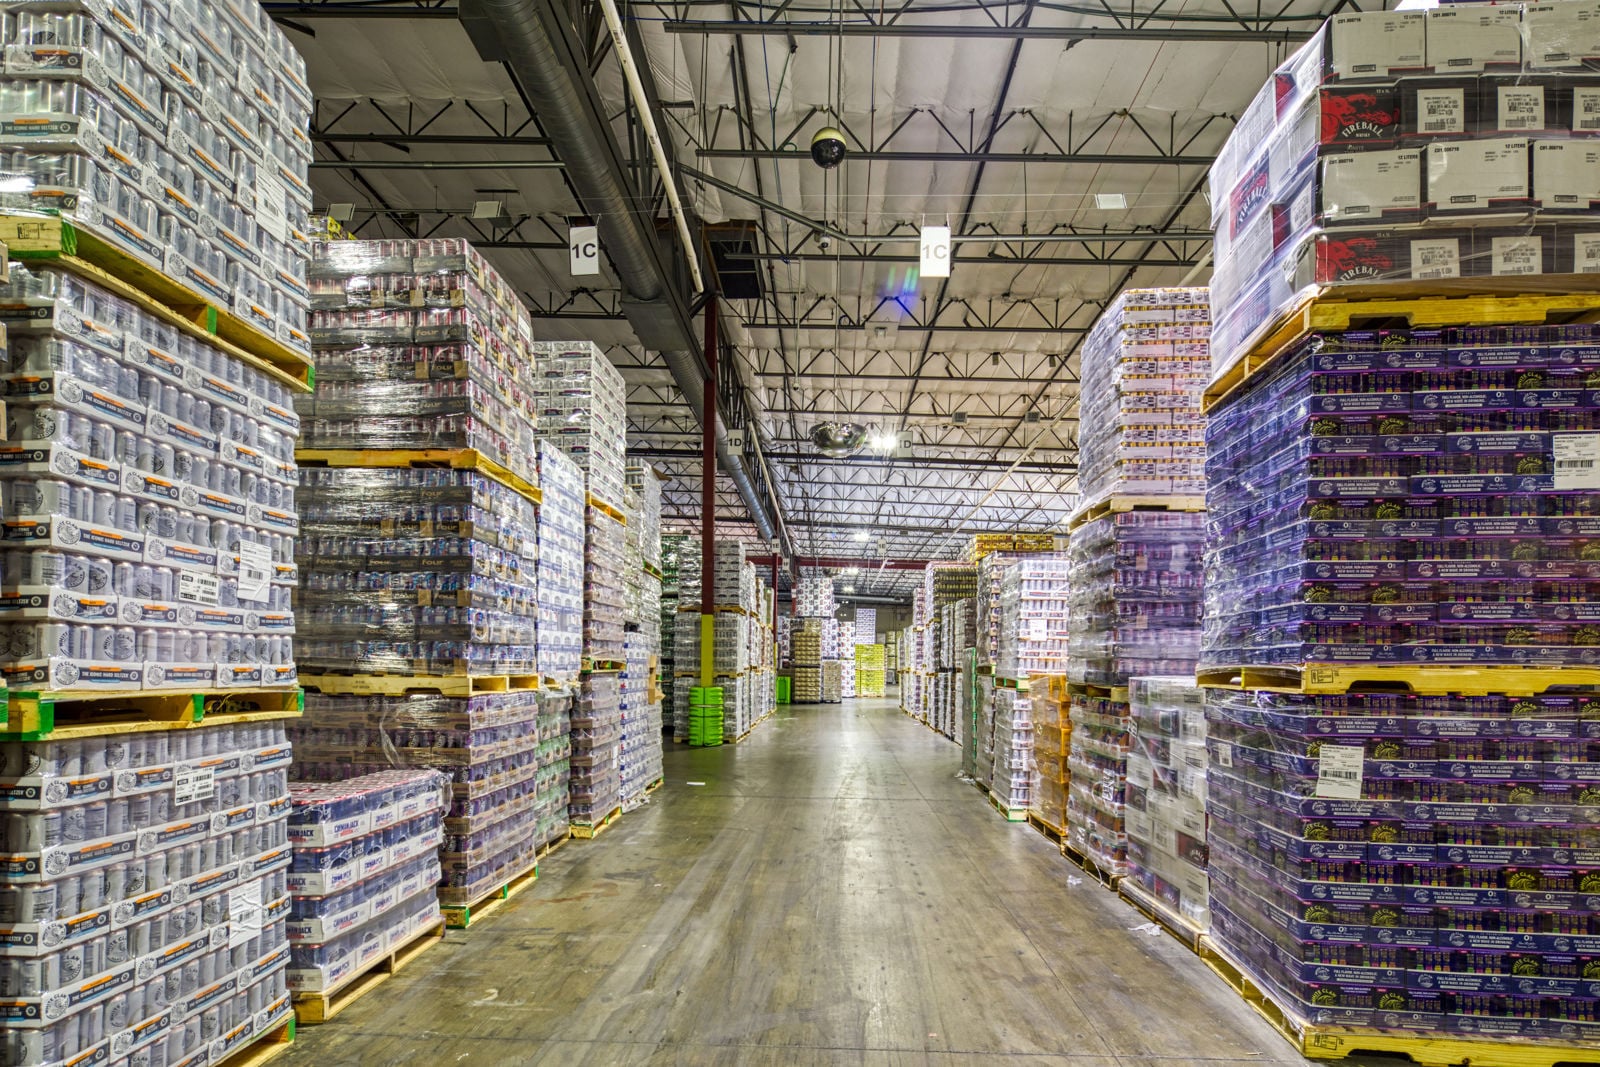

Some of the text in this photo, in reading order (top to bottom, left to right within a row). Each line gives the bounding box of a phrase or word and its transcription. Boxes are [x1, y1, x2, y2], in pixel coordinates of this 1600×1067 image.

[1341, 121, 1384, 138] FIREBALL
[571, 242, 596, 259] 1C
[922, 243, 948, 260] 1C
[728, 438, 742, 447] 1D
[300, 829, 314, 837] JACK
